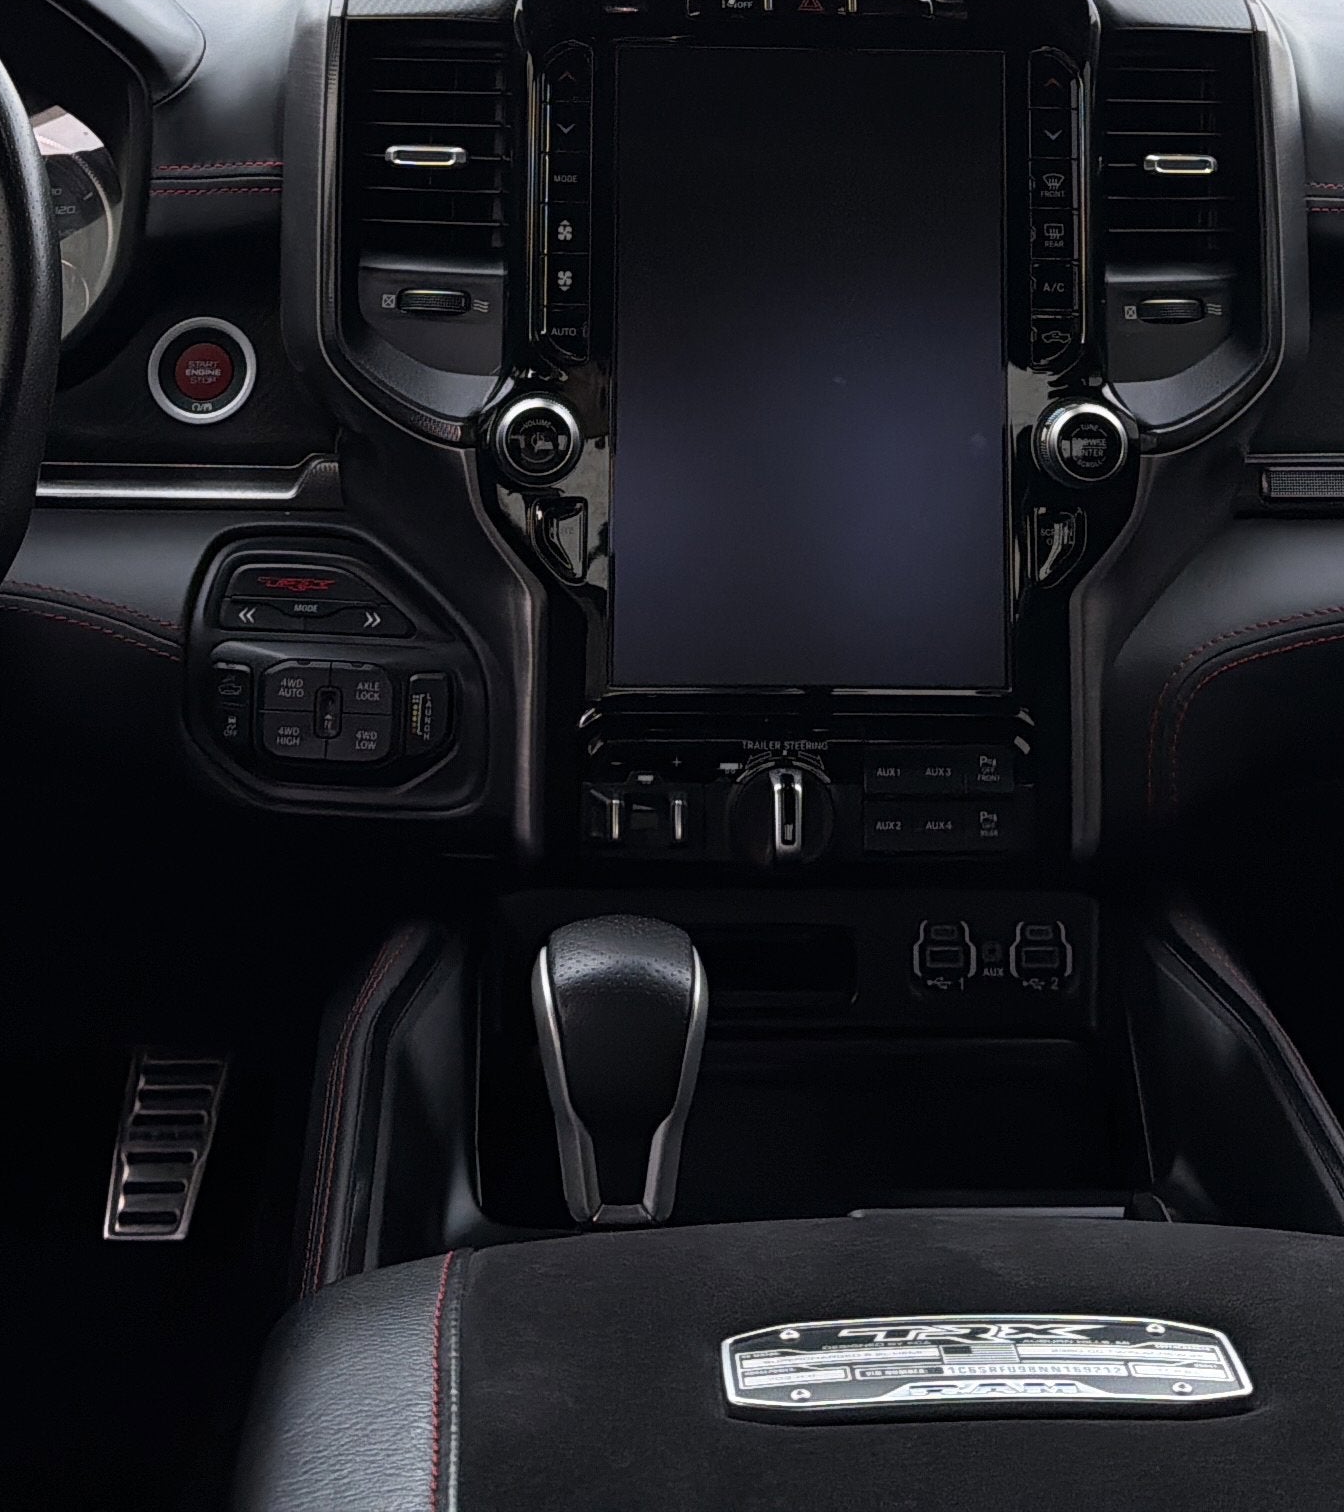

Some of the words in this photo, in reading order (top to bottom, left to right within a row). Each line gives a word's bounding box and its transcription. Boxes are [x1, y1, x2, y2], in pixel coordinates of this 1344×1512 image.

[553, 174, 578, 185] MODE
[1040, 188, 1067, 199] FRONT
[1042, 282, 1065, 294] A/C
[550, 327, 577, 337] AUTO
[187, 360, 220, 370] START
[185, 368, 222, 377] ENGINE
[257, 574, 337, 593] TRX
[293, 602, 319, 614] MODE
[281, 677, 304, 688] 4WD
[356, 681, 380, 692] AXLE
[278, 687, 305, 698] AUTO
[355, 691, 381, 702] LOCK
[277, 726, 301, 737] 4WD
[355, 730, 378, 741] 4WD
[276, 736, 301, 747] HIGH
[355, 740, 377, 751] LOW
[742, 740, 782, 751] TRAILER
[783, 740, 830, 751] STEERING
[876, 767, 902, 777] AUX1
[925, 767, 952, 777] AUX3
[875, 820, 902, 830] AUX2
[925, 820, 953, 830] AUX4
[982, 967, 1004, 977] AUX
[839, 1324, 1110, 1345] TRX
[905, 1381, 1082, 1396] RAM
